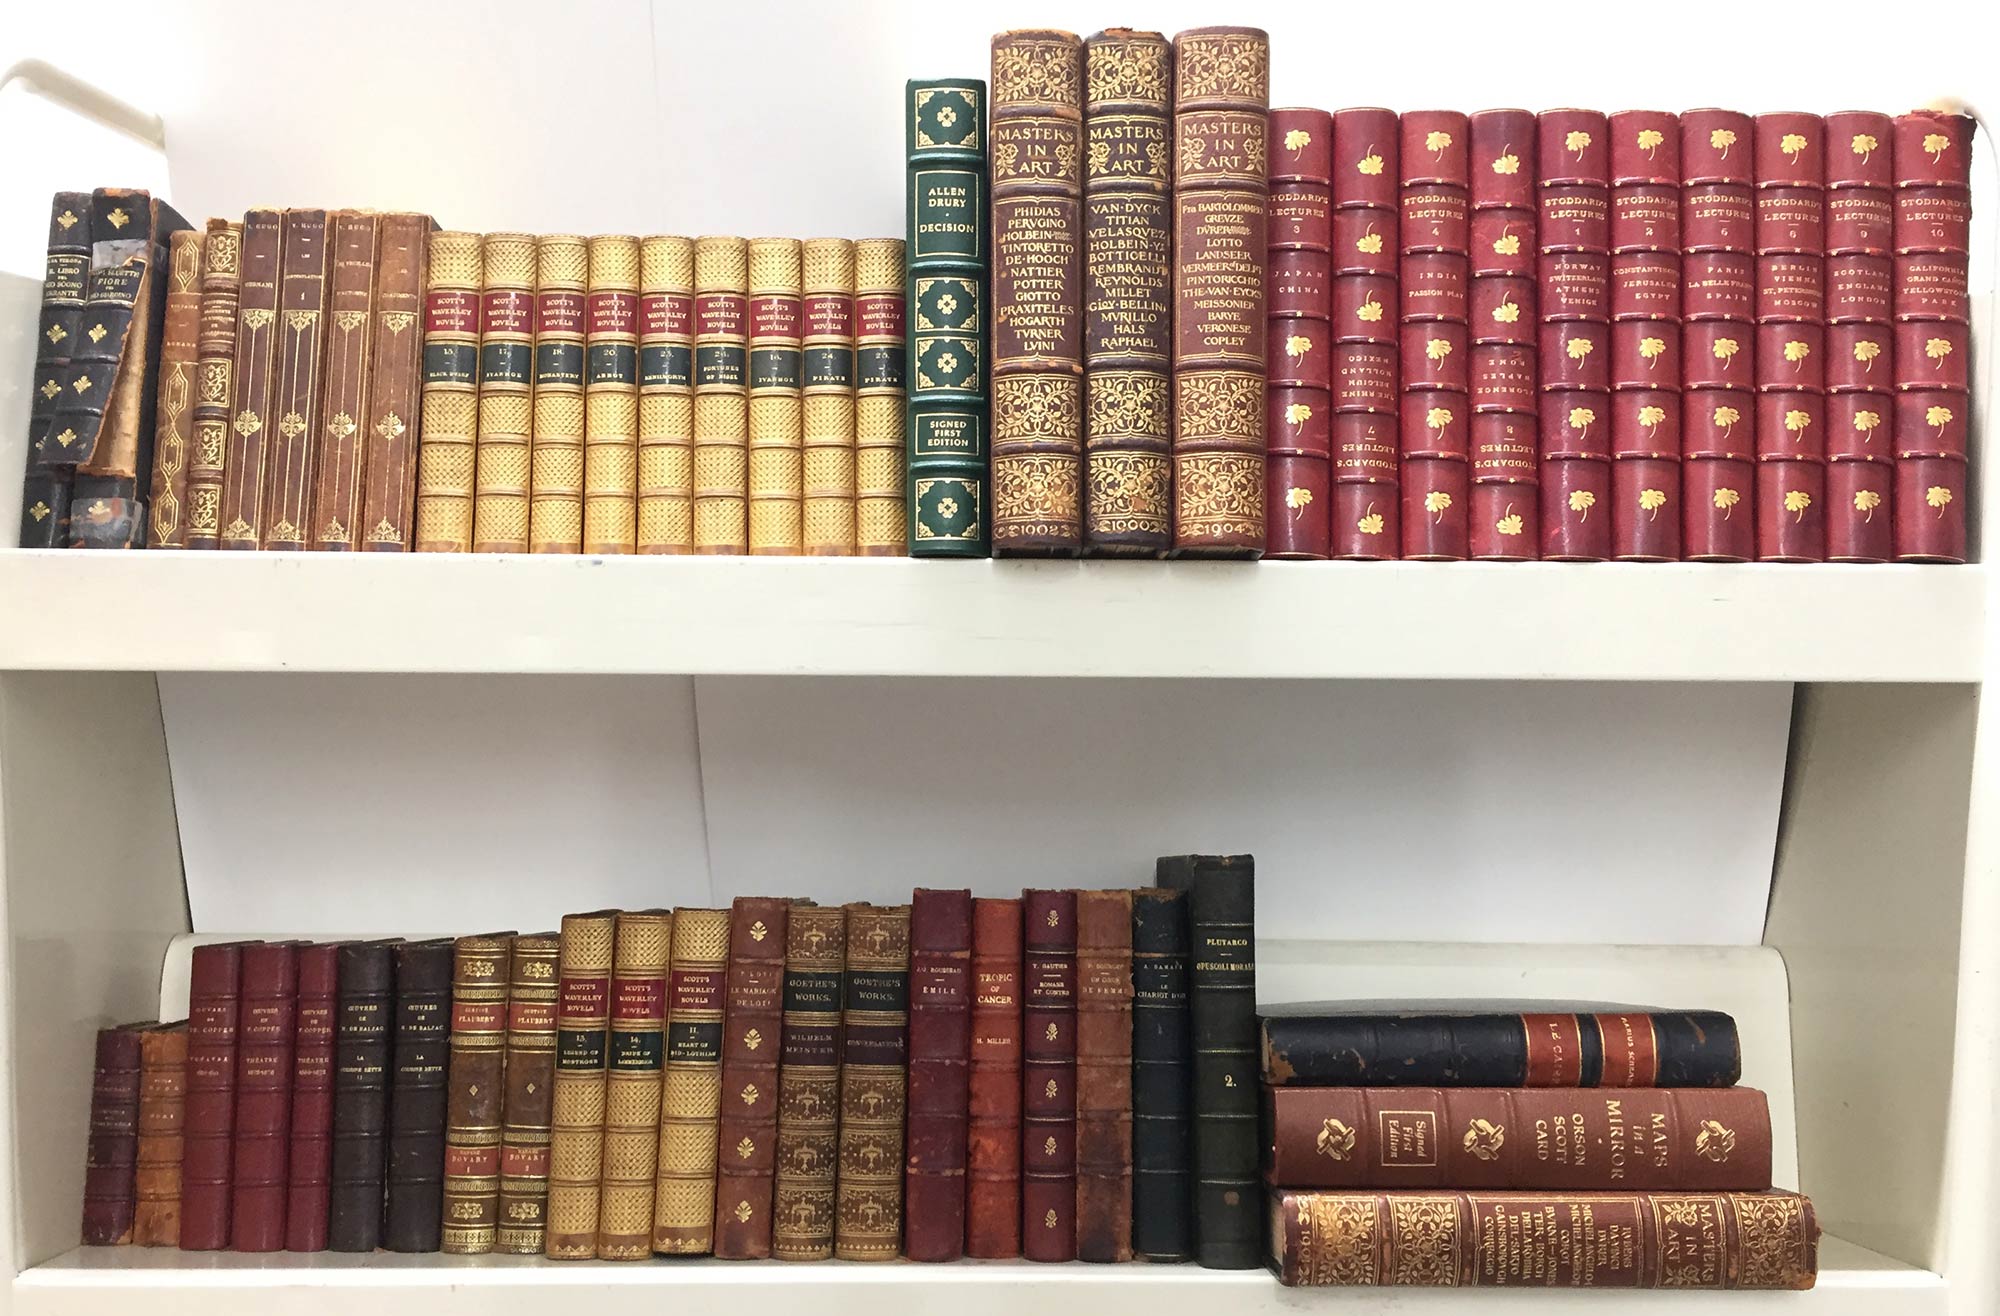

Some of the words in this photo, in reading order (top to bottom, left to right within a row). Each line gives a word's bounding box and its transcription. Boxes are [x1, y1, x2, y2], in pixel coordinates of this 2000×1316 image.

[1090, 126, 1163, 140] MASTERS
[1185, 122, 1261, 135] MASTERS
[999, 128, 1073, 142] MASTERS
[1119, 143, 1137, 154] IN
[1215, 139, 1234, 150] IN
[1027, 145, 1046, 156] IN
[1111, 160, 1144, 173] ART
[1207, 156, 1241, 169] ART
[1019, 162, 1052, 176] ART
[929, 187, 966, 196] ALLEN
[929, 199, 966, 207] DRURY
[1015, 207, 1060, 216] PHIDIAS
[1269, 207, 1324, 217] LECTURES
[1409, 210, 1463, 220] LECTURES
[1551, 209, 1604, 220] LECTURES
[1105, 215, 1149, 225] TITIAN
[920, 223, 974, 233] DECISION
[1294, 225, 1300, 233] 3
[1432, 228, 1439, 236] 4
[1646, 227, 1653, 236] 2
[1931, 229, 1944, 237] 10
[1001, 242, 1074, 254] TINTORETTO
[1206, 239, 1242, 247] LOTTO
[1089, 251, 1165, 263] BOTTICELLI
[1196, 251, 1252, 260] LANDSEER
[1011, 267, 1066, 279] NATTIER
[1275, 270, 1322, 278] JAPAN
[1420, 272, 1456, 280] INDIA
[1014, 279, 1064, 290] POTTER
[1096, 276, 1162, 288] REYNOLDS
[1187, 275, 1260, 286] PINTORICCHIO
[1016, 292, 1060, 301] GIOTTO
[1106, 288, 1151, 297] MILLET
[1001, 304, 1074, 316] PRAXITELES
[1194, 300, 1255, 309] MEISSONIER
[1010, 317, 1065, 327] HOGARTH
[1208, 312, 1240, 321] BARYE
[1114, 324, 1145, 334] HALS
[1197, 324, 1251, 334] VERONESE
[1101, 337, 1157, 349] RAPHAEL
[1204, 337, 1245, 346] COPLEY
[930, 420, 967, 428] SIGNED
[853, 978, 901, 987] GOETHE'S
[980, 973, 1013, 982] TROPIC
[789, 979, 837, 988] GOETHE'S
[978, 996, 1013, 1004] CANCER
[1225, 1075, 1237, 1087] 2.
[1388, 1120, 1400, 1158] Edition
[1402, 1126, 1413, 1152] First
[1415, 1120, 1427, 1157] Signed
[1536, 1119, 1549, 1161] CARD
[1554, 1116, 1568, 1165] SCOTT
[1572, 1113, 1586, 1167] ORSON
[1606, 1099, 1625, 1180] MIRROR
[1651, 1112, 1668, 1168] MAPS
[1483, 1216, 1495, 1276] CORREGGIO
[1559, 1229, 1570, 1265] COROT
[1667, 1228, 1680, 1260] ART
[1686, 1236, 1697, 1255] IN
[1699, 1205, 1715, 1281] MASTERS
